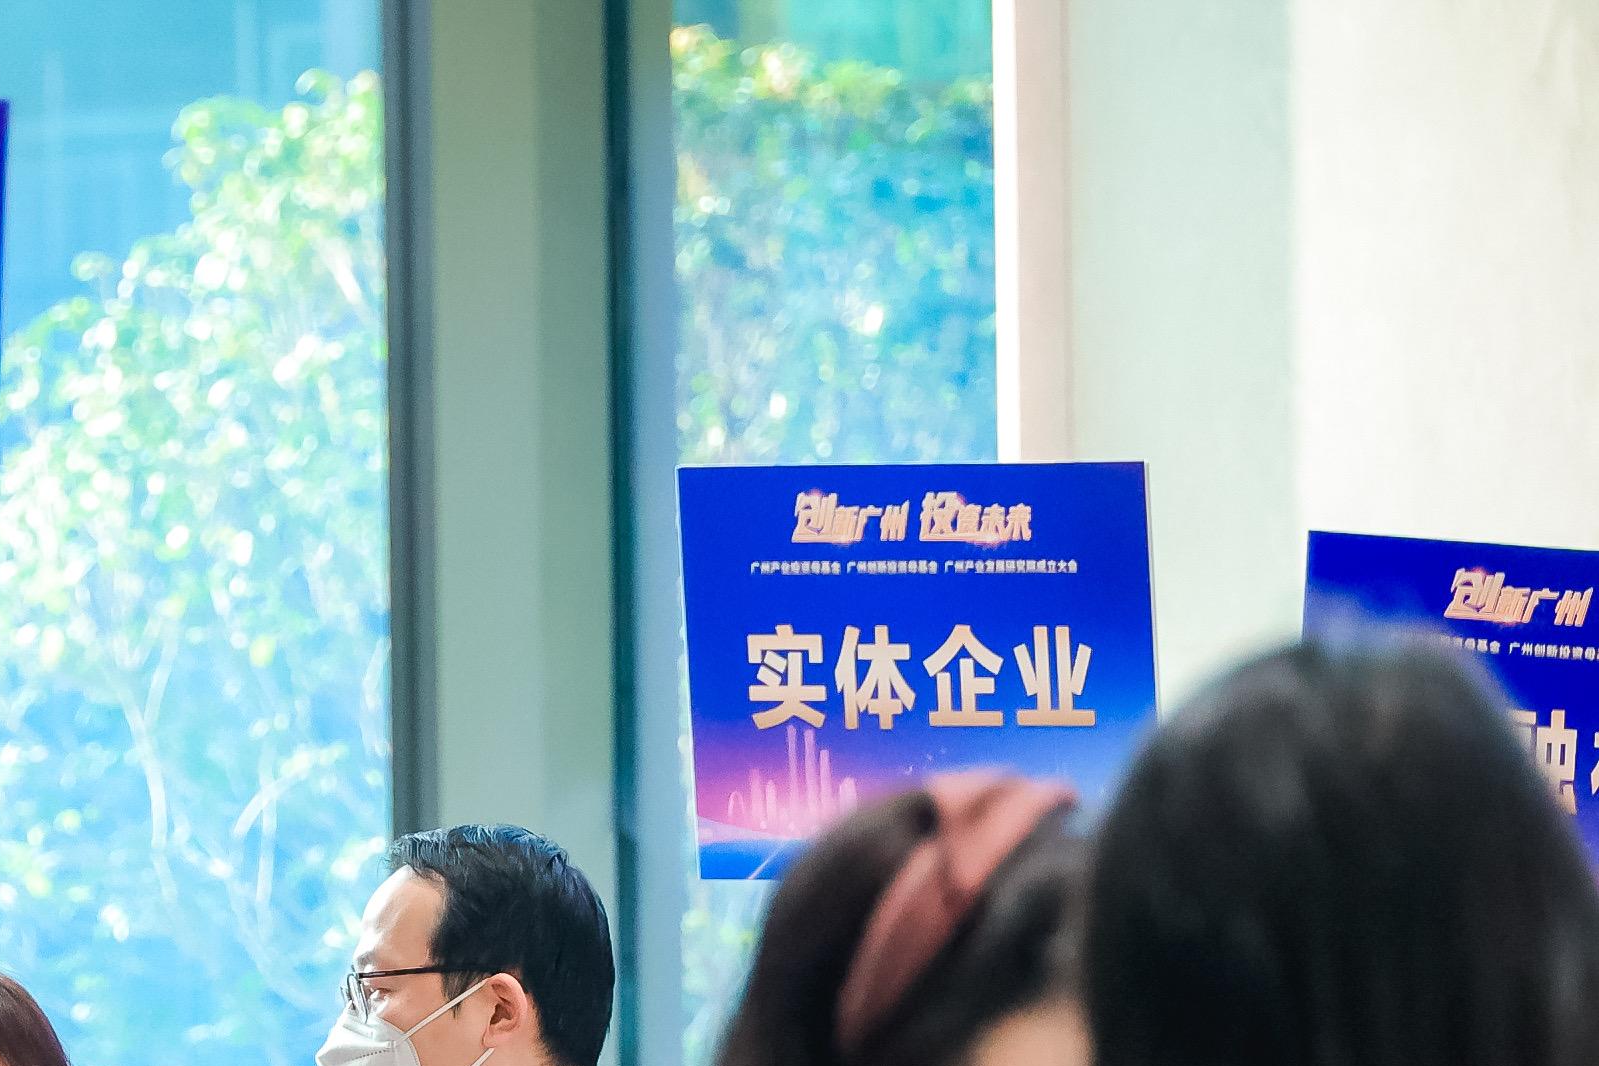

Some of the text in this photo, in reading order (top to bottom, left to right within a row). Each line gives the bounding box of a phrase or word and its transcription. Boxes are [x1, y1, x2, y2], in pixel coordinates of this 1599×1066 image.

[792, 492, 1033, 544] 创新广州 投资未来
[1444, 568, 1594, 628] 创新广州
[746, 624, 1097, 731] 实体企业
